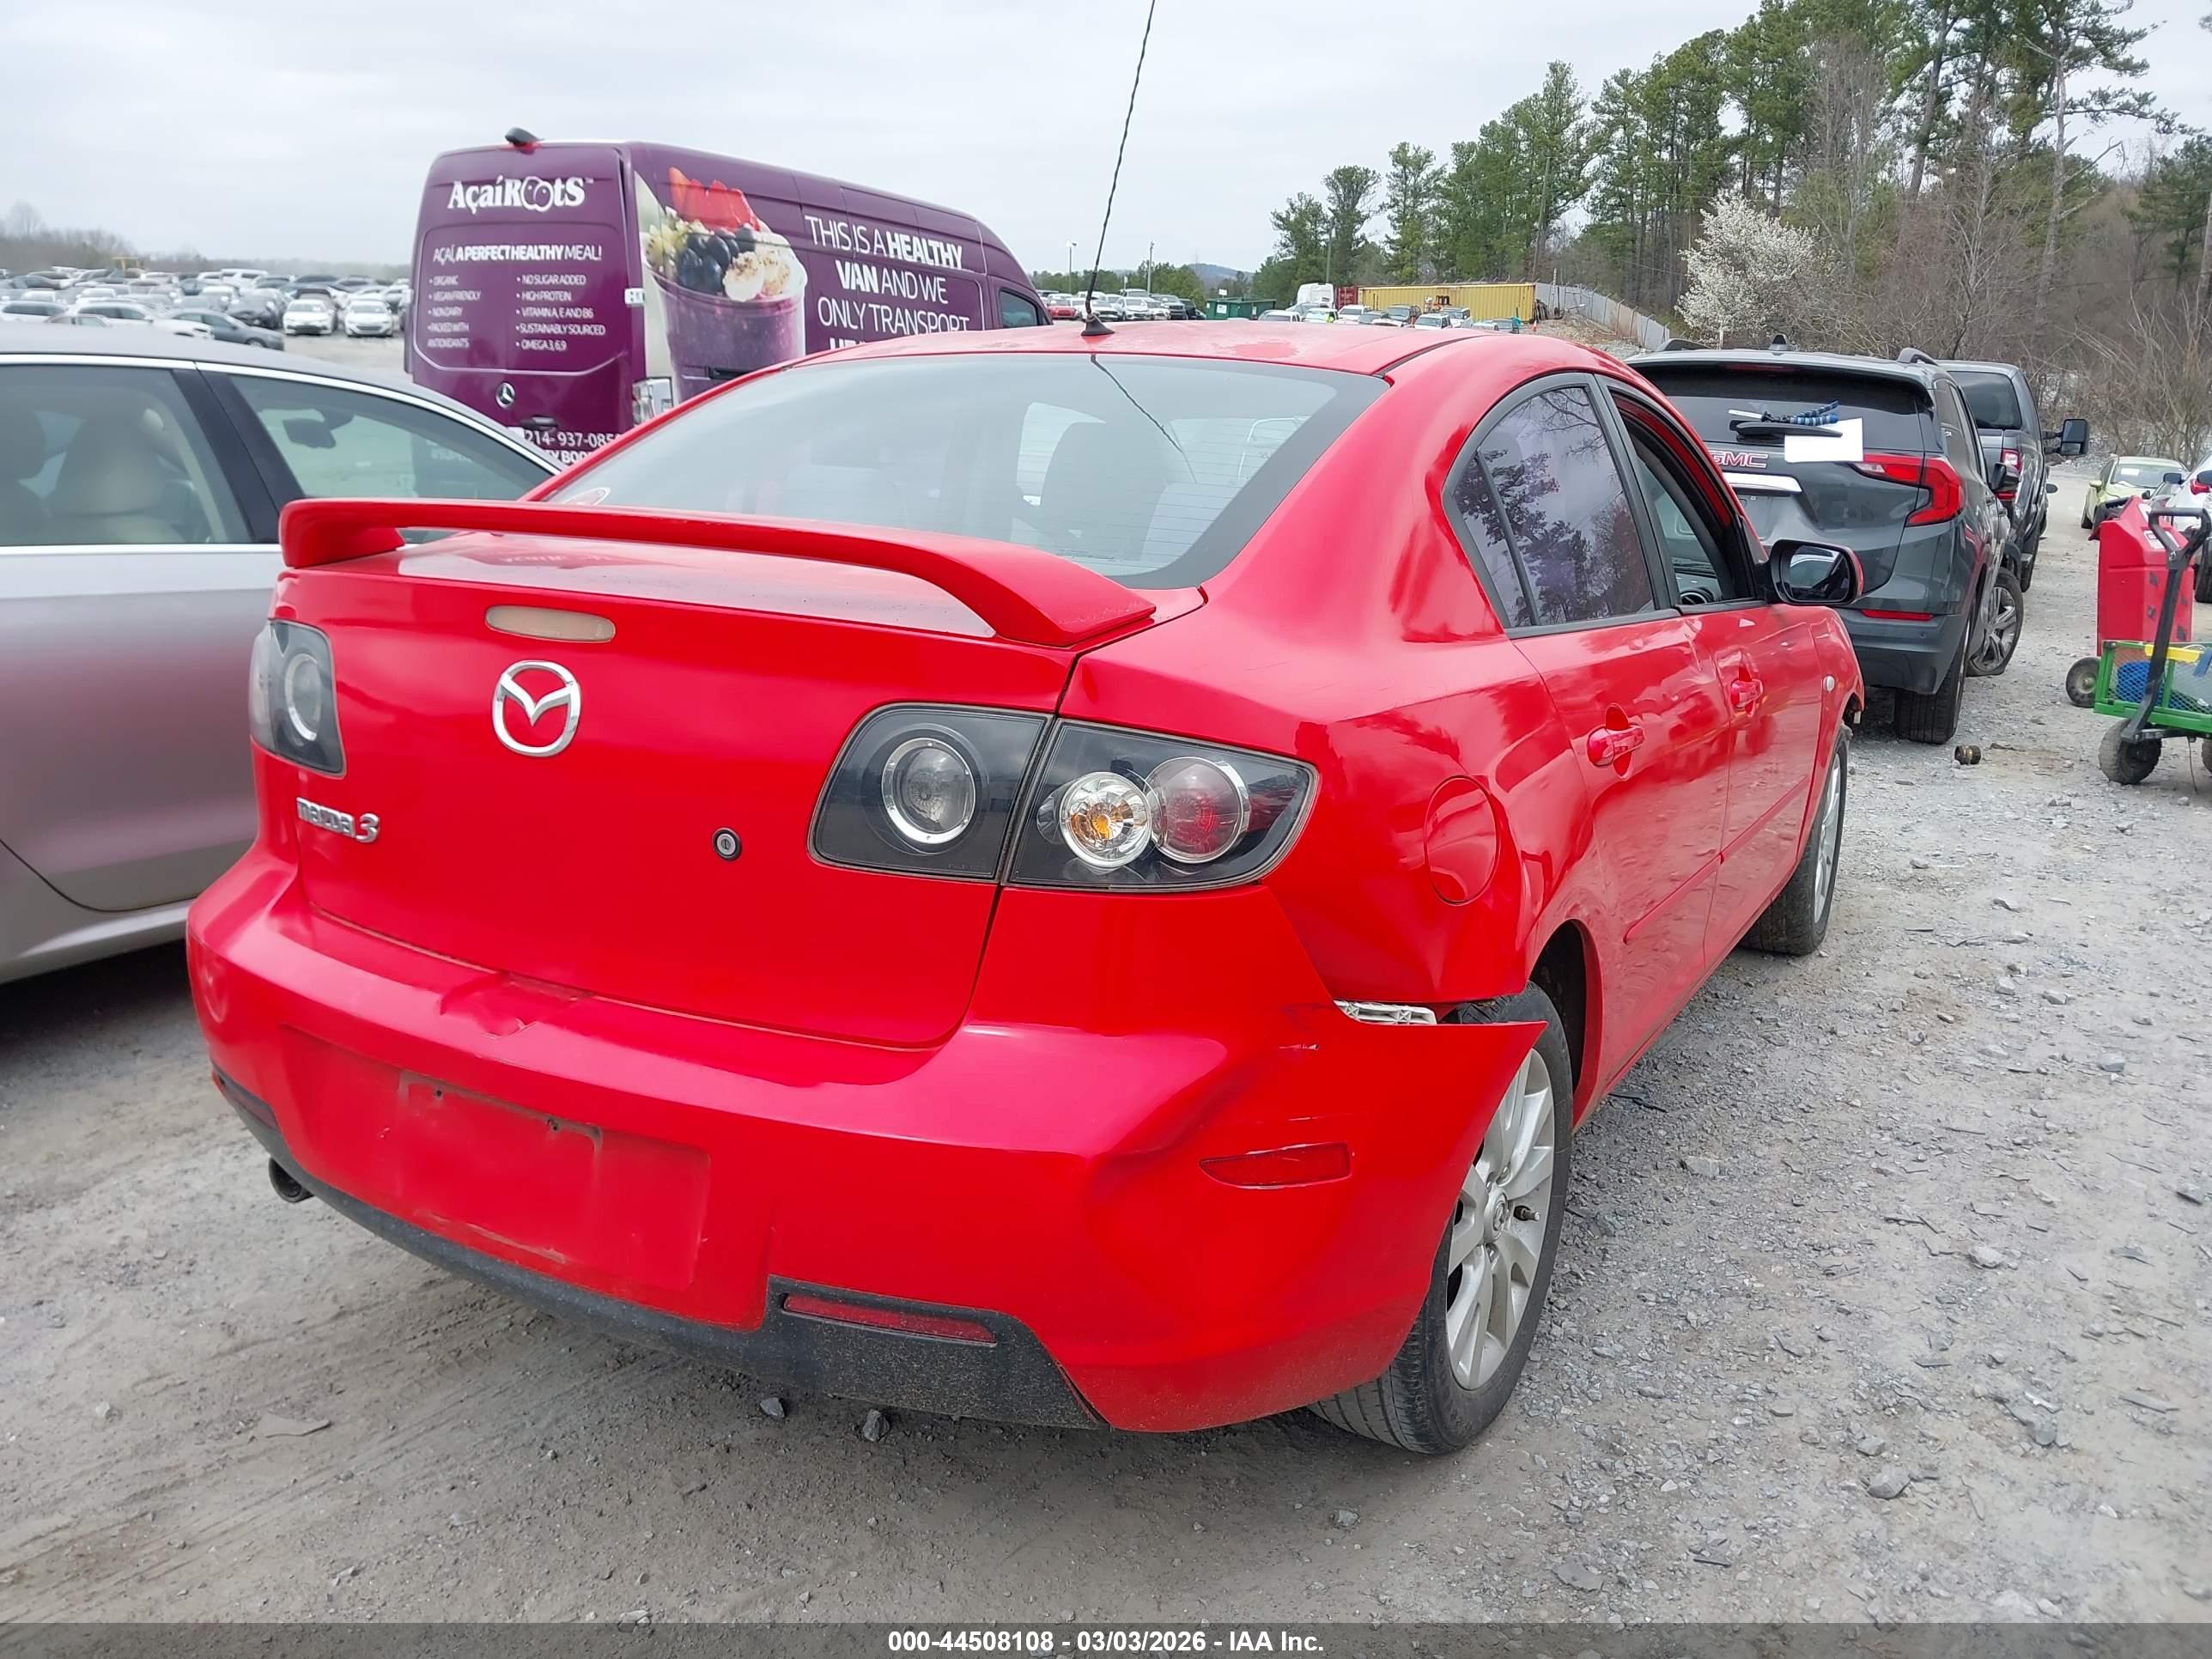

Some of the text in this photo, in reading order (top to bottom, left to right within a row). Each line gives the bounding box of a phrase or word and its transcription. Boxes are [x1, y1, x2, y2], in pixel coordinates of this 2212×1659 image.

[465, 245, 511, 261] PERFECT
[511, 244, 563, 261] HEALTHY
[564, 244, 602, 261] MEAL!
[805, 216, 963, 270] THIS IS A HEALTHY
[522, 275, 586, 286] NO SUGAR ADDED
[836, 259, 949, 304] VAN AND WE
[539, 291, 572, 301] PROTEIN
[817, 296, 970, 336] ONLY TRANSPORT
